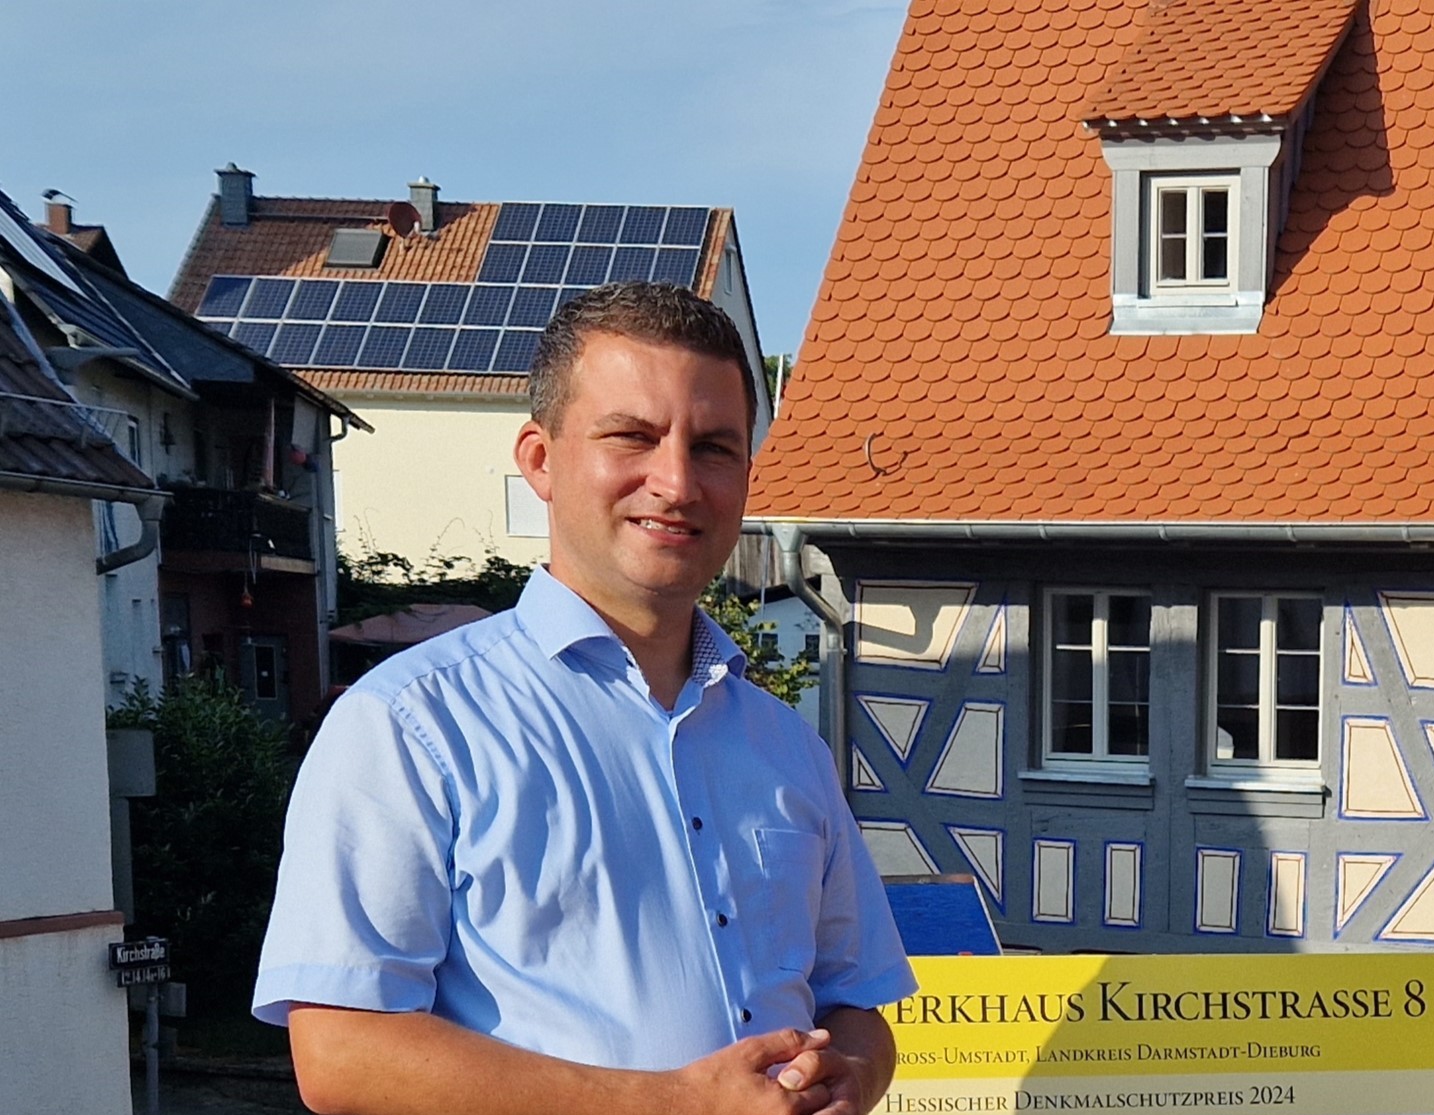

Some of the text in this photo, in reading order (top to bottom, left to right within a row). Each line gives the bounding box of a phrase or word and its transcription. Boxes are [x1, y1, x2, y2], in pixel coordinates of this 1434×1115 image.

[117, 943, 165, 963] Kirchstraße
[881, 979, 1426, 1024] ERKHAUS KIRCHSTRASSE 8
[897, 1042, 1321, 1064] ROSS-UMSTADT, LANDKREIS DARMSTADT-DIEBURG
[886, 1085, 1296, 1113] HESSISCHER DENKMALSCHUTZPREIS 2024
